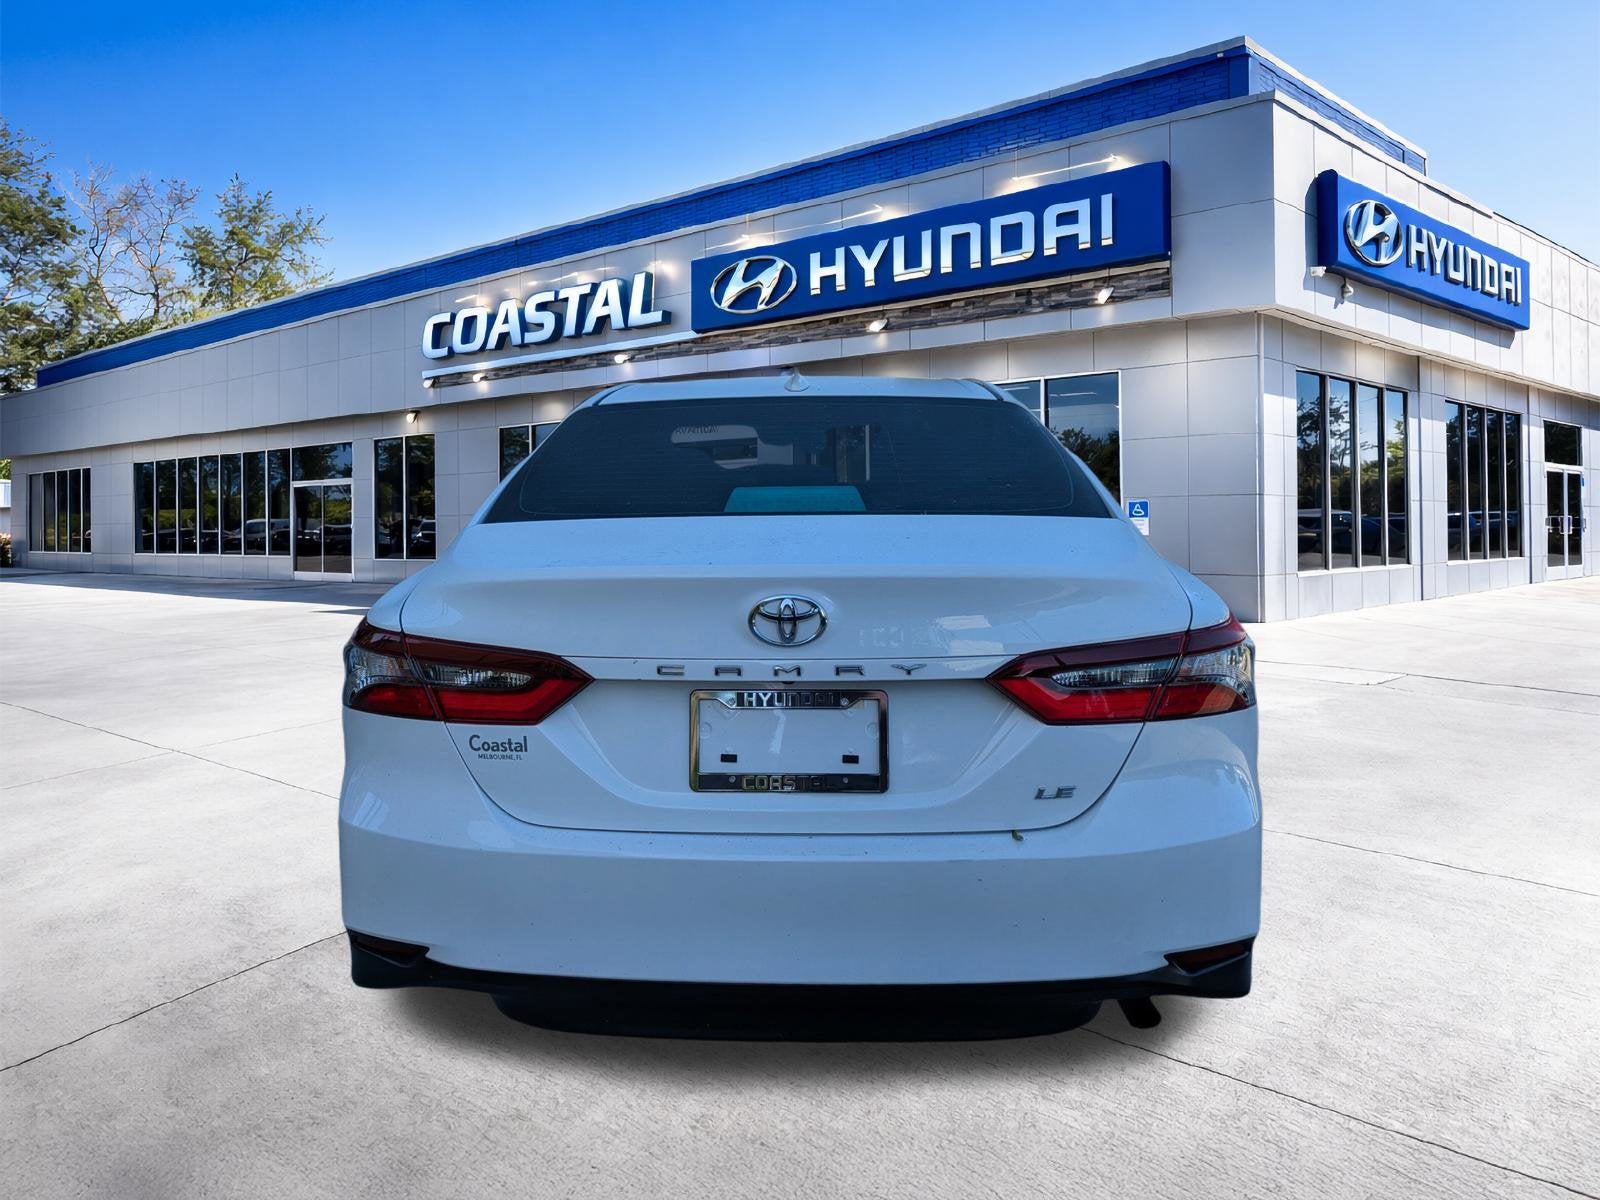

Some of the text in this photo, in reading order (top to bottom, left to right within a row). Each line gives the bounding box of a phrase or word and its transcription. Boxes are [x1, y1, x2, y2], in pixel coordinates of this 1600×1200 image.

[809, 193, 1113, 296] HYUNDAI
[1407, 224, 1522, 306] HYUNDAI
[422, 271, 667, 360] COASTAL
[656, 663, 927, 676] CAMRY
[743, 692, 834, 707] HYUNDAI
[469, 734, 528, 752] Coastal
[1034, 786, 1077, 800] LE
